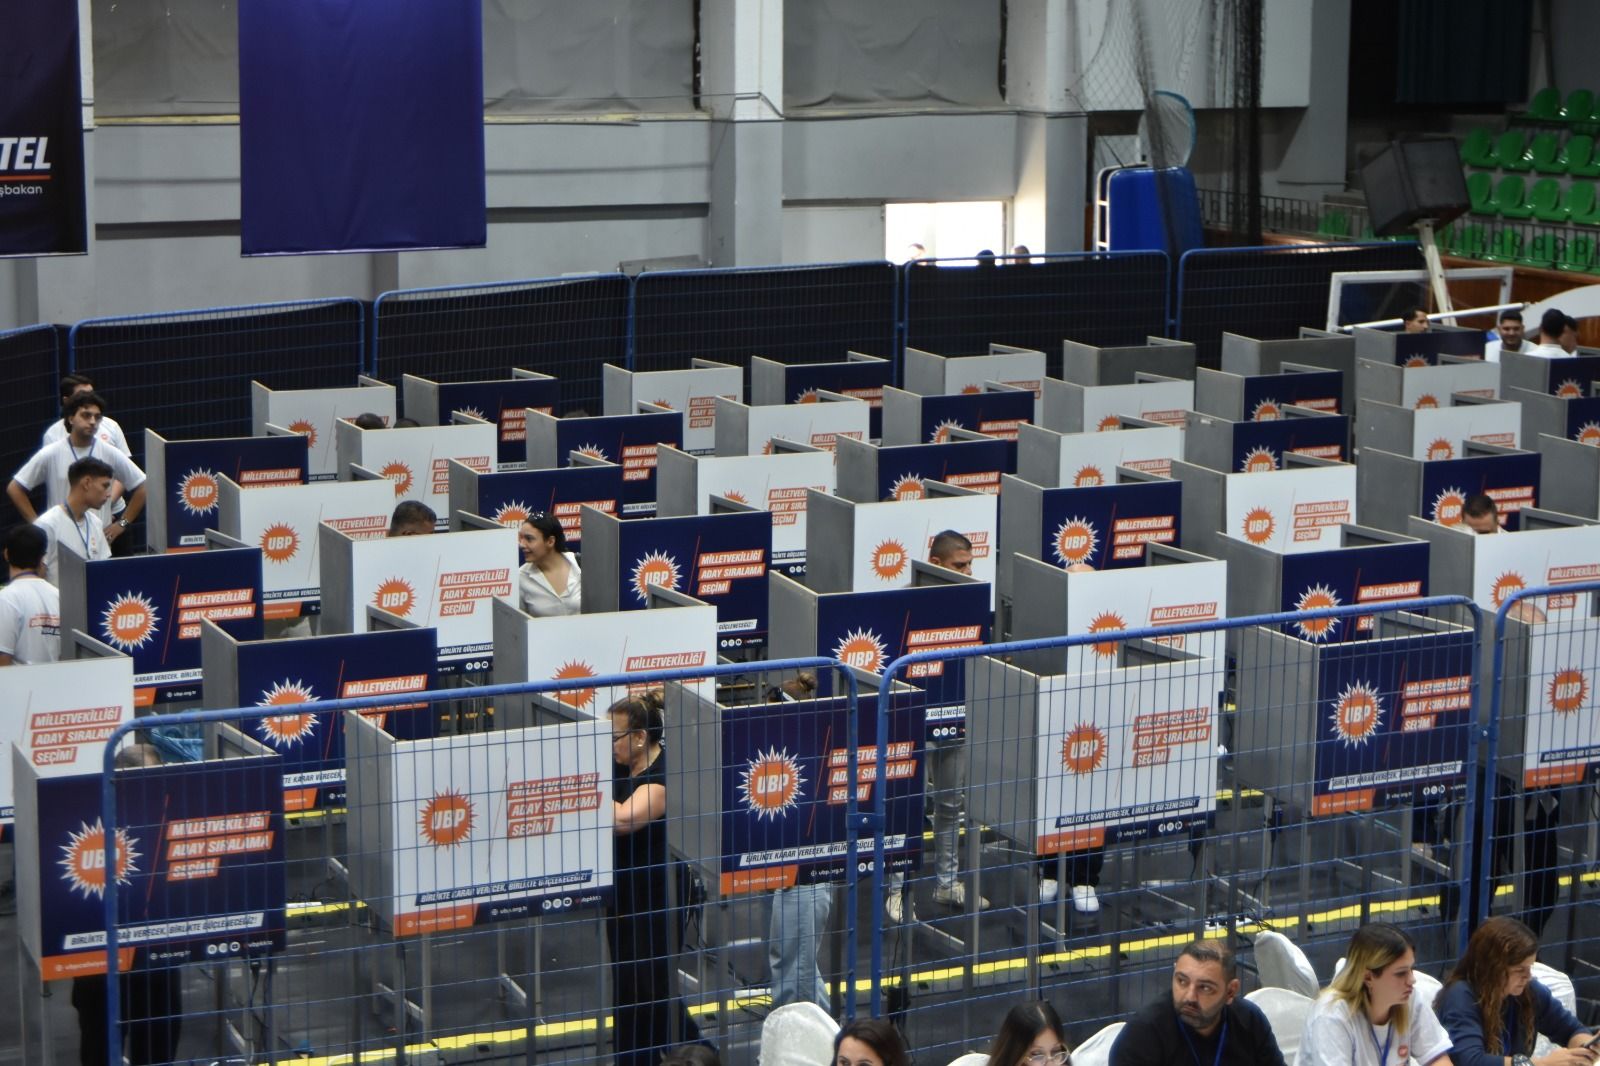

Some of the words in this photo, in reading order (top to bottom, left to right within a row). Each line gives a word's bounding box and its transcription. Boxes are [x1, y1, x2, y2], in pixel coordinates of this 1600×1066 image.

[241, 469, 299, 482] MİLLETVEKİLLİĞİ
[625, 469, 648, 480] SEÇİMİ
[190, 485, 213, 498] UBP
[770, 502, 790, 512] ADAY
[1116, 517, 1172, 531] MİLLETVEKİLLİĞİ
[1249, 519, 1268, 532] UBP
[268, 535, 292, 550] UBP
[1065, 535, 1087, 549] UBP
[1116, 532, 1136, 544] ADAY
[701, 551, 762, 565] MİLLETVEKİLLİĞİ
[879, 552, 901, 567] UBP
[1116, 546, 1142, 558] SEÇİMİ
[442, 569, 508, 584] MİLLETVEKİLLİĞİ
[645, 571, 669, 585] UBP
[701, 567, 722, 579] ADAY
[723, 566, 763, 578] SIRALAMA
[442, 588, 465, 600] ADAY
[467, 585, 510, 597] SIRALAMA
[701, 581, 729, 595] SEÇİMİ
[182, 590, 250, 606] MİLLETVEKİLLİĞİ
[382, 591, 408, 607] UBP
[182, 608, 206, 621] ADAY
[209, 605, 253, 618] SIRALAMA
[442, 603, 473, 616] SEÇİMİ
[1153, 604, 1215, 618] MİLLETVEKİLLİĞİ
[117, 613, 145, 630] UBP
[910, 626, 978, 643] MİLLETVEKİLLİĞİ
[629, 653, 703, 669] MİLLETVEKİLLİĞİ
[847, 650, 874, 667] UBP
[911, 662, 941, 676] SEÇİMİ
[347, 677, 424, 695] MİLLETVEKİLLİĞİ
[1555, 682, 1582, 700] UBP
[35, 708, 119, 728] MİLLETVEKİLLİĞİ
[1344, 705, 1371, 723] UBP
[35, 733, 65, 746] ADAY
[36, 748, 74, 764] SEÇİMİ
[1070, 740, 1098, 759] UBP
[756, 773, 789, 794] UBP
[432, 808, 466, 830] UBP
[71, 934, 104, 946] BİRLİKTE
